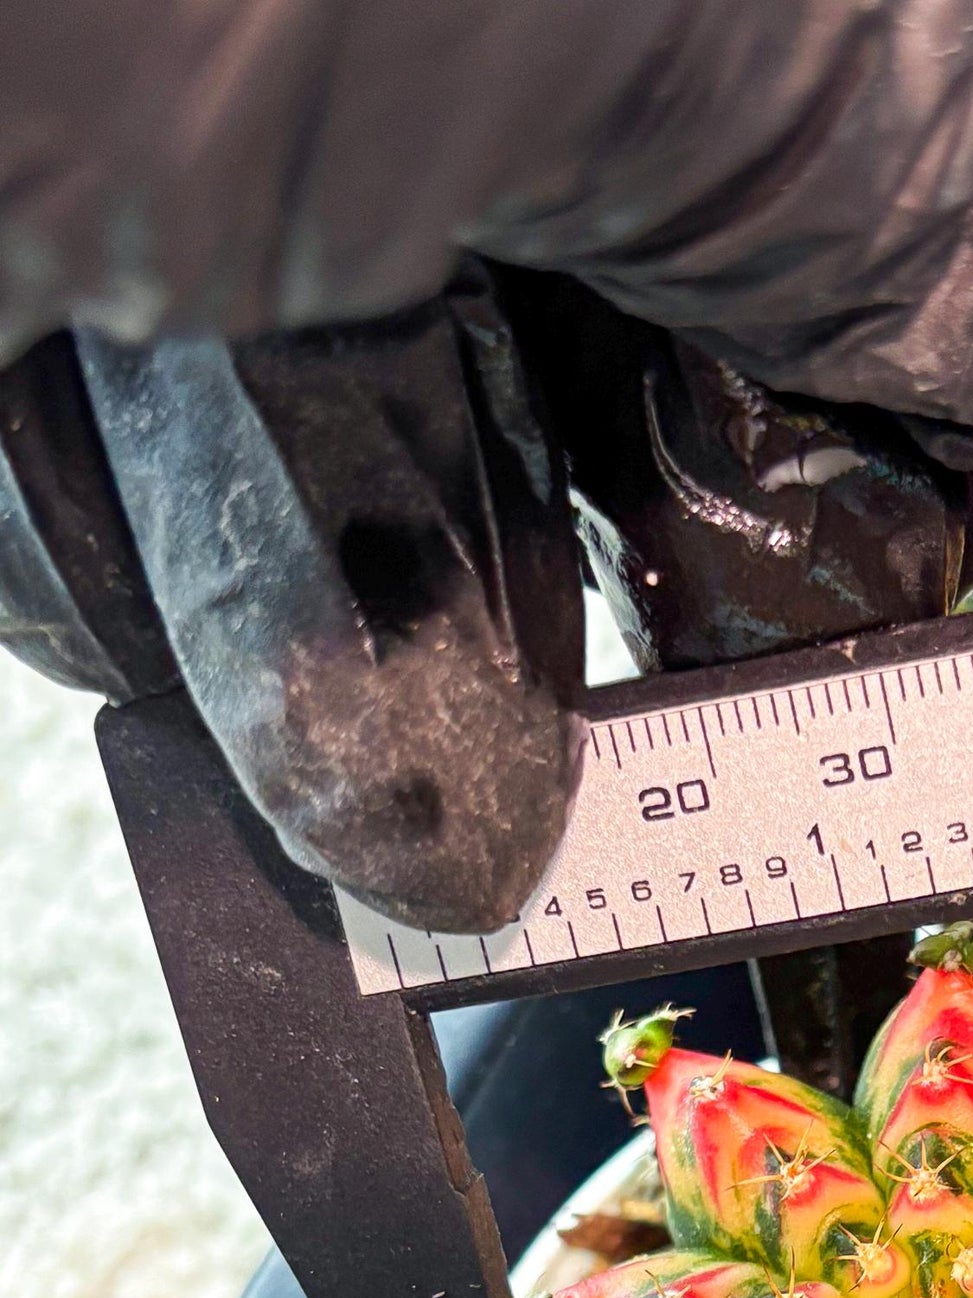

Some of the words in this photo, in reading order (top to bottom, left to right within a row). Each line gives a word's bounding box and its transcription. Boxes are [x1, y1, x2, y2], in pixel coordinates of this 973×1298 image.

[638, 779, 710, 822] 20
[819, 745, 893, 787] 30
[544, 896, 562, 916] 4
[586, 888, 607, 909] 5
[630, 880, 652, 901] 6
[679, 872, 695, 892] 7
[719, 864, 743, 885] 8
[765, 856, 787, 879] 9
[807, 822, 825, 855] 1
[866, 840, 876, 859] 1
[901, 830, 923, 852] 2
[947, 822, 969, 843] 3
